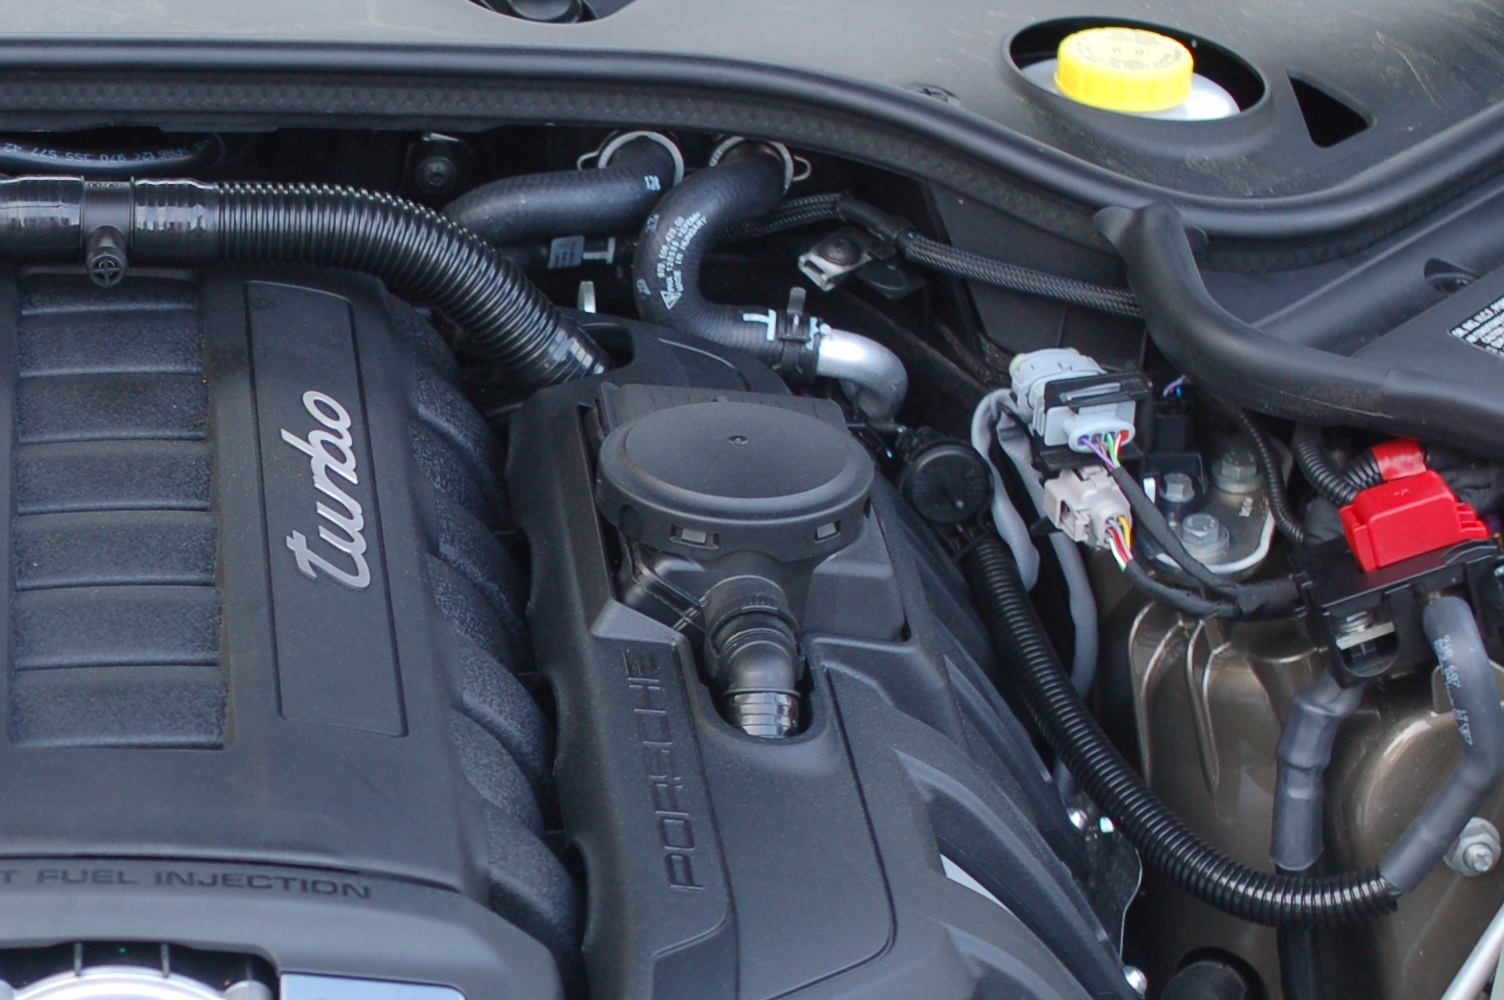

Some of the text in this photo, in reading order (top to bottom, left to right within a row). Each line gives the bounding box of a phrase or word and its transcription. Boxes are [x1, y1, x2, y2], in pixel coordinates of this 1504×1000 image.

[284, 388, 374, 591] turbo
[622, 649, 707, 894] PORSCHE
[36, 866, 139, 888] FUEL
[153, 869, 372, 900] INJECTION
